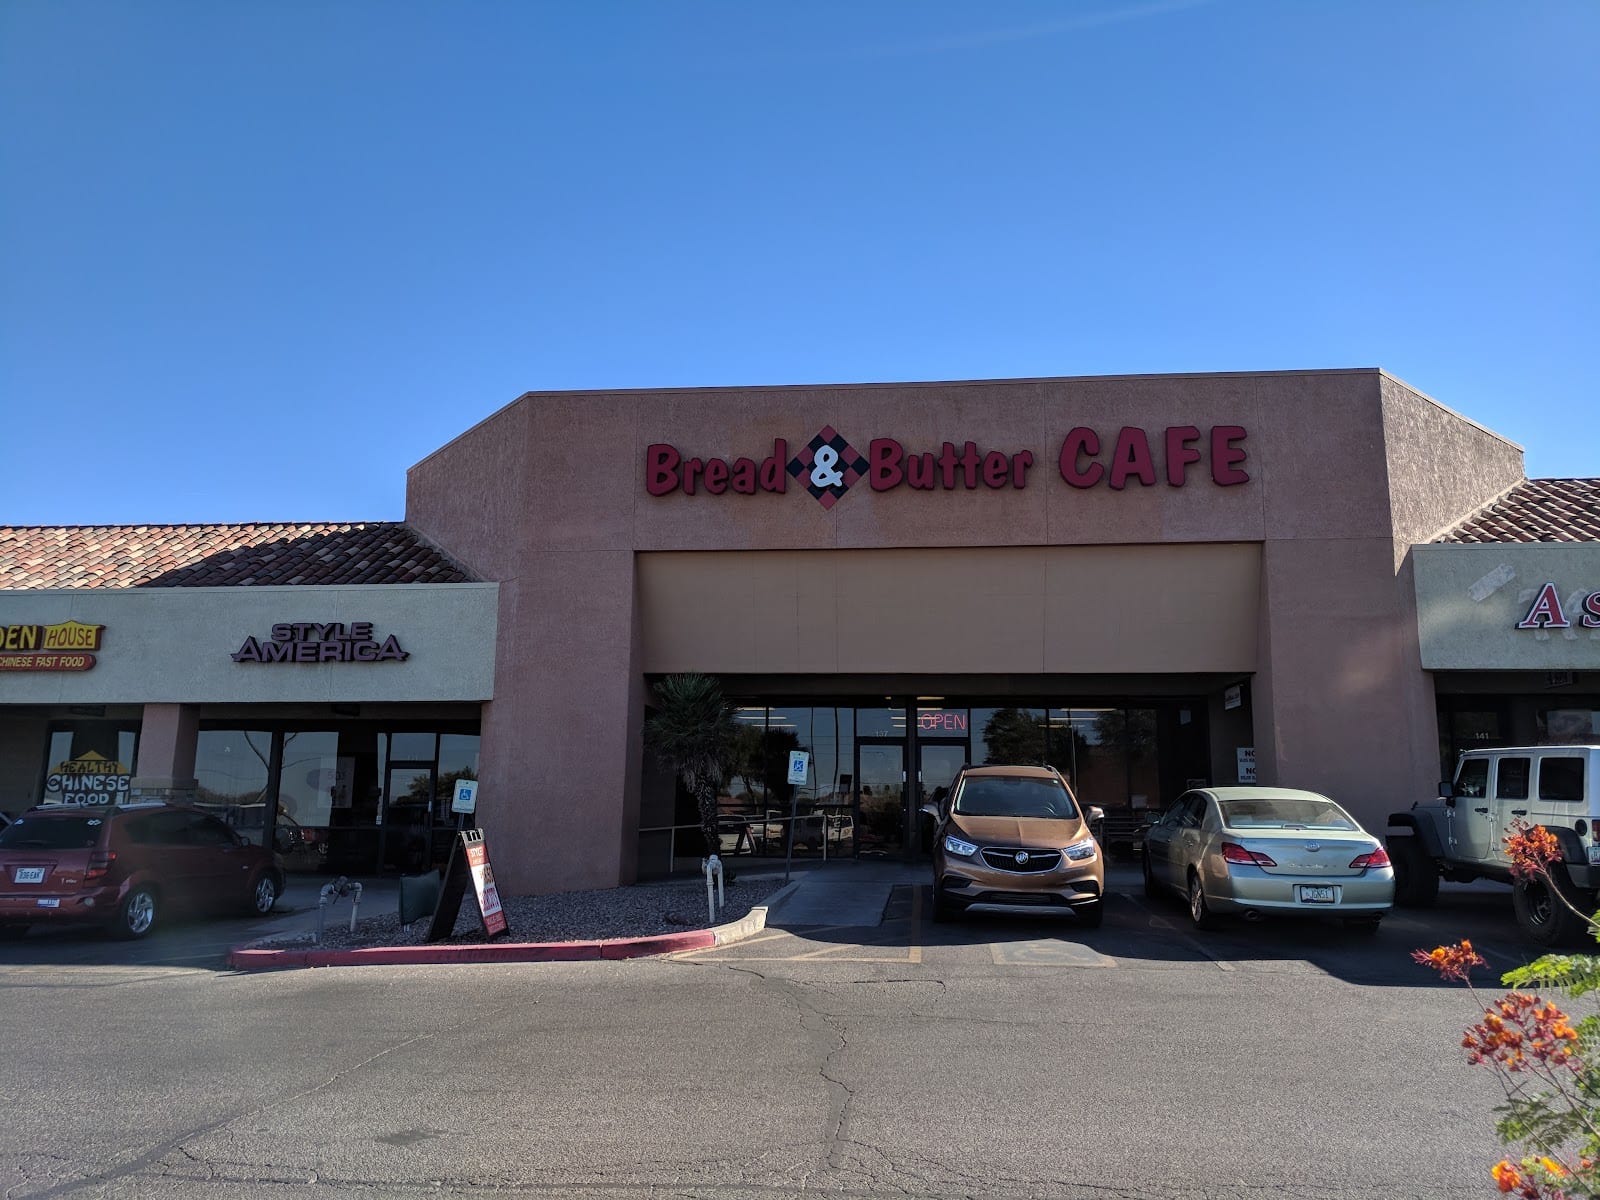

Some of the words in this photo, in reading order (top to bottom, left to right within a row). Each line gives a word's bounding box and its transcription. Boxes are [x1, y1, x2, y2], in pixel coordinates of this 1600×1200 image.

[646, 438, 788, 498] Bread
[810, 444, 844, 489] &
[869, 437, 1034, 492] Butter
[1058, 425, 1250, 491] CAFE
[47, 627, 94, 647] HOUSE
[271, 621, 374, 642] STYLE
[230, 634, 411, 663] AMERICA
[35, 656, 58, 668] FAST
[59, 656, 86, 668] FOOD
[921, 713, 966, 730] OPEN
[60, 761, 119, 773] HEALTHY
[46, 773, 130, 792] CHINESE
[63, 792, 110, 806] FOOD
